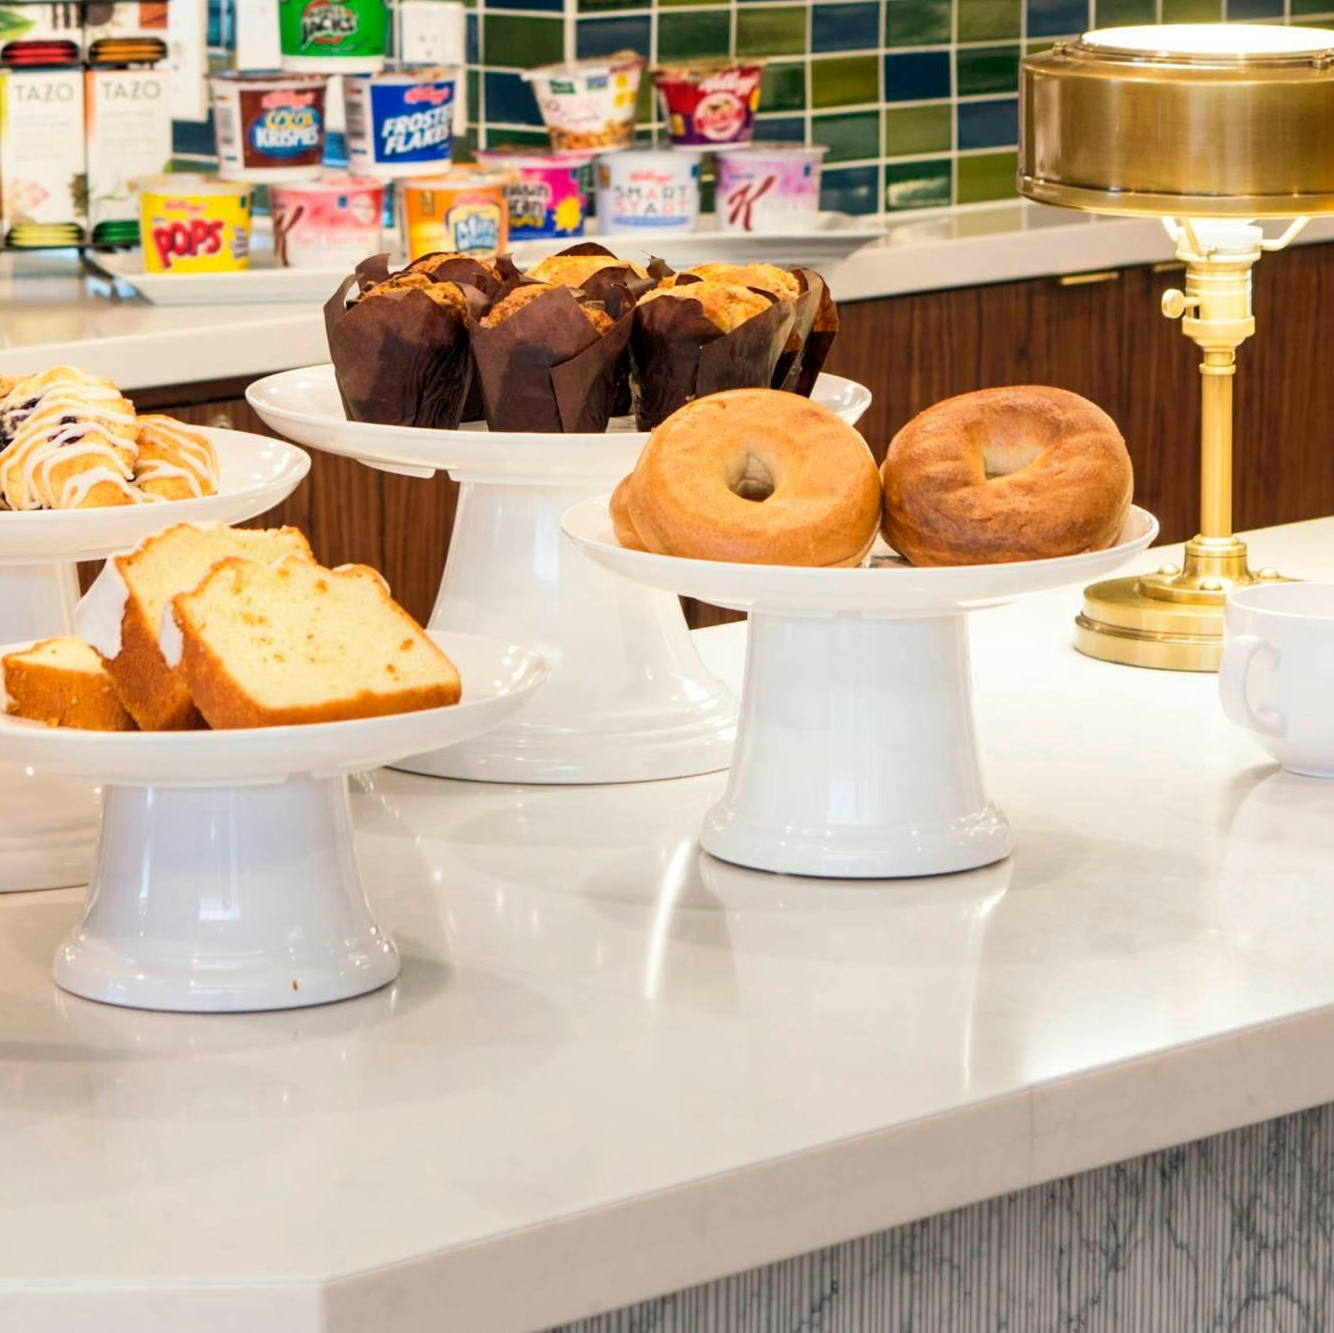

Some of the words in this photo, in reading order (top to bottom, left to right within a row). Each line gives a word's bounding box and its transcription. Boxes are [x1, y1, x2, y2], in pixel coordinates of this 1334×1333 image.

[14, 82, 74, 103] TAZO
[102, 80, 161, 101] TAZO
[614, 185, 689, 200] SMART
[614, 201, 689, 215] START
[151, 218, 225, 270] POPS
